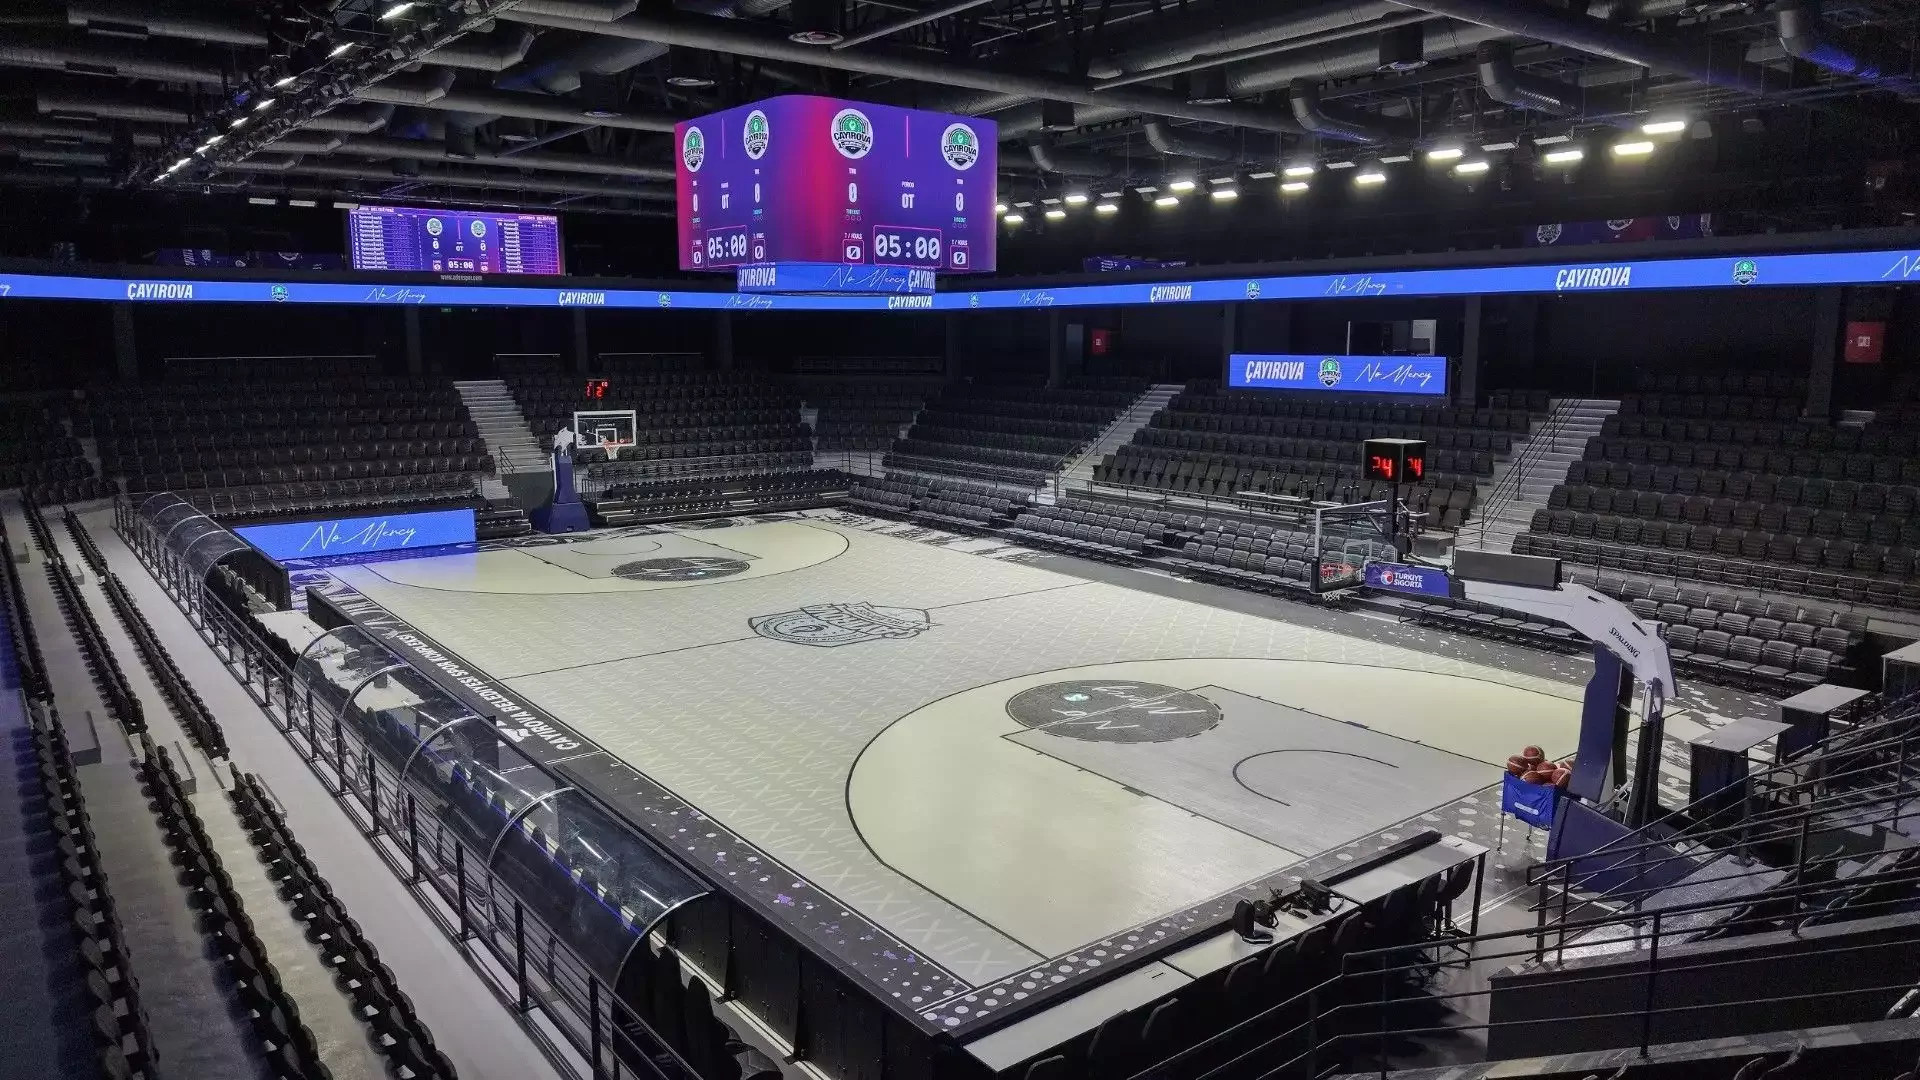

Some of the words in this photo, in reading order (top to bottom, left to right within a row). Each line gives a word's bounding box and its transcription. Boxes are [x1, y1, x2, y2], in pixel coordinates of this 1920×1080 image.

[849, 182, 858, 203] 0
[955, 192, 964, 212] 0
[708, 233, 747, 259] 05:00
[846, 245, 861, 260] 0
[875, 233, 941, 260] 05:00
[448, 260, 474, 269] 05:00
[953, 251, 967, 265] 0
[822, 264, 855, 289] No
[855, 268, 907, 292] Mercy
[1555, 266, 1632, 290] ÇAYIROVA
[127, 283, 193, 300] ÇAYIROVA
[558, 291, 605, 306] ÇAYIROVA
[888, 295, 932, 309] ÇAYIROVA
[1150, 285, 1192, 303] ÇAYIROVA
[1245, 361, 1305, 383] ÇAYIROVA
[1354, 362, 1382, 384] No
[1381, 363, 1433, 387] Mercy
[300, 522, 341, 552] No
[342, 520, 416, 547] Mercy
[1608, 627, 1641, 658] SPALDING
[510, 710, 581, 750] ÇAYIROVA
